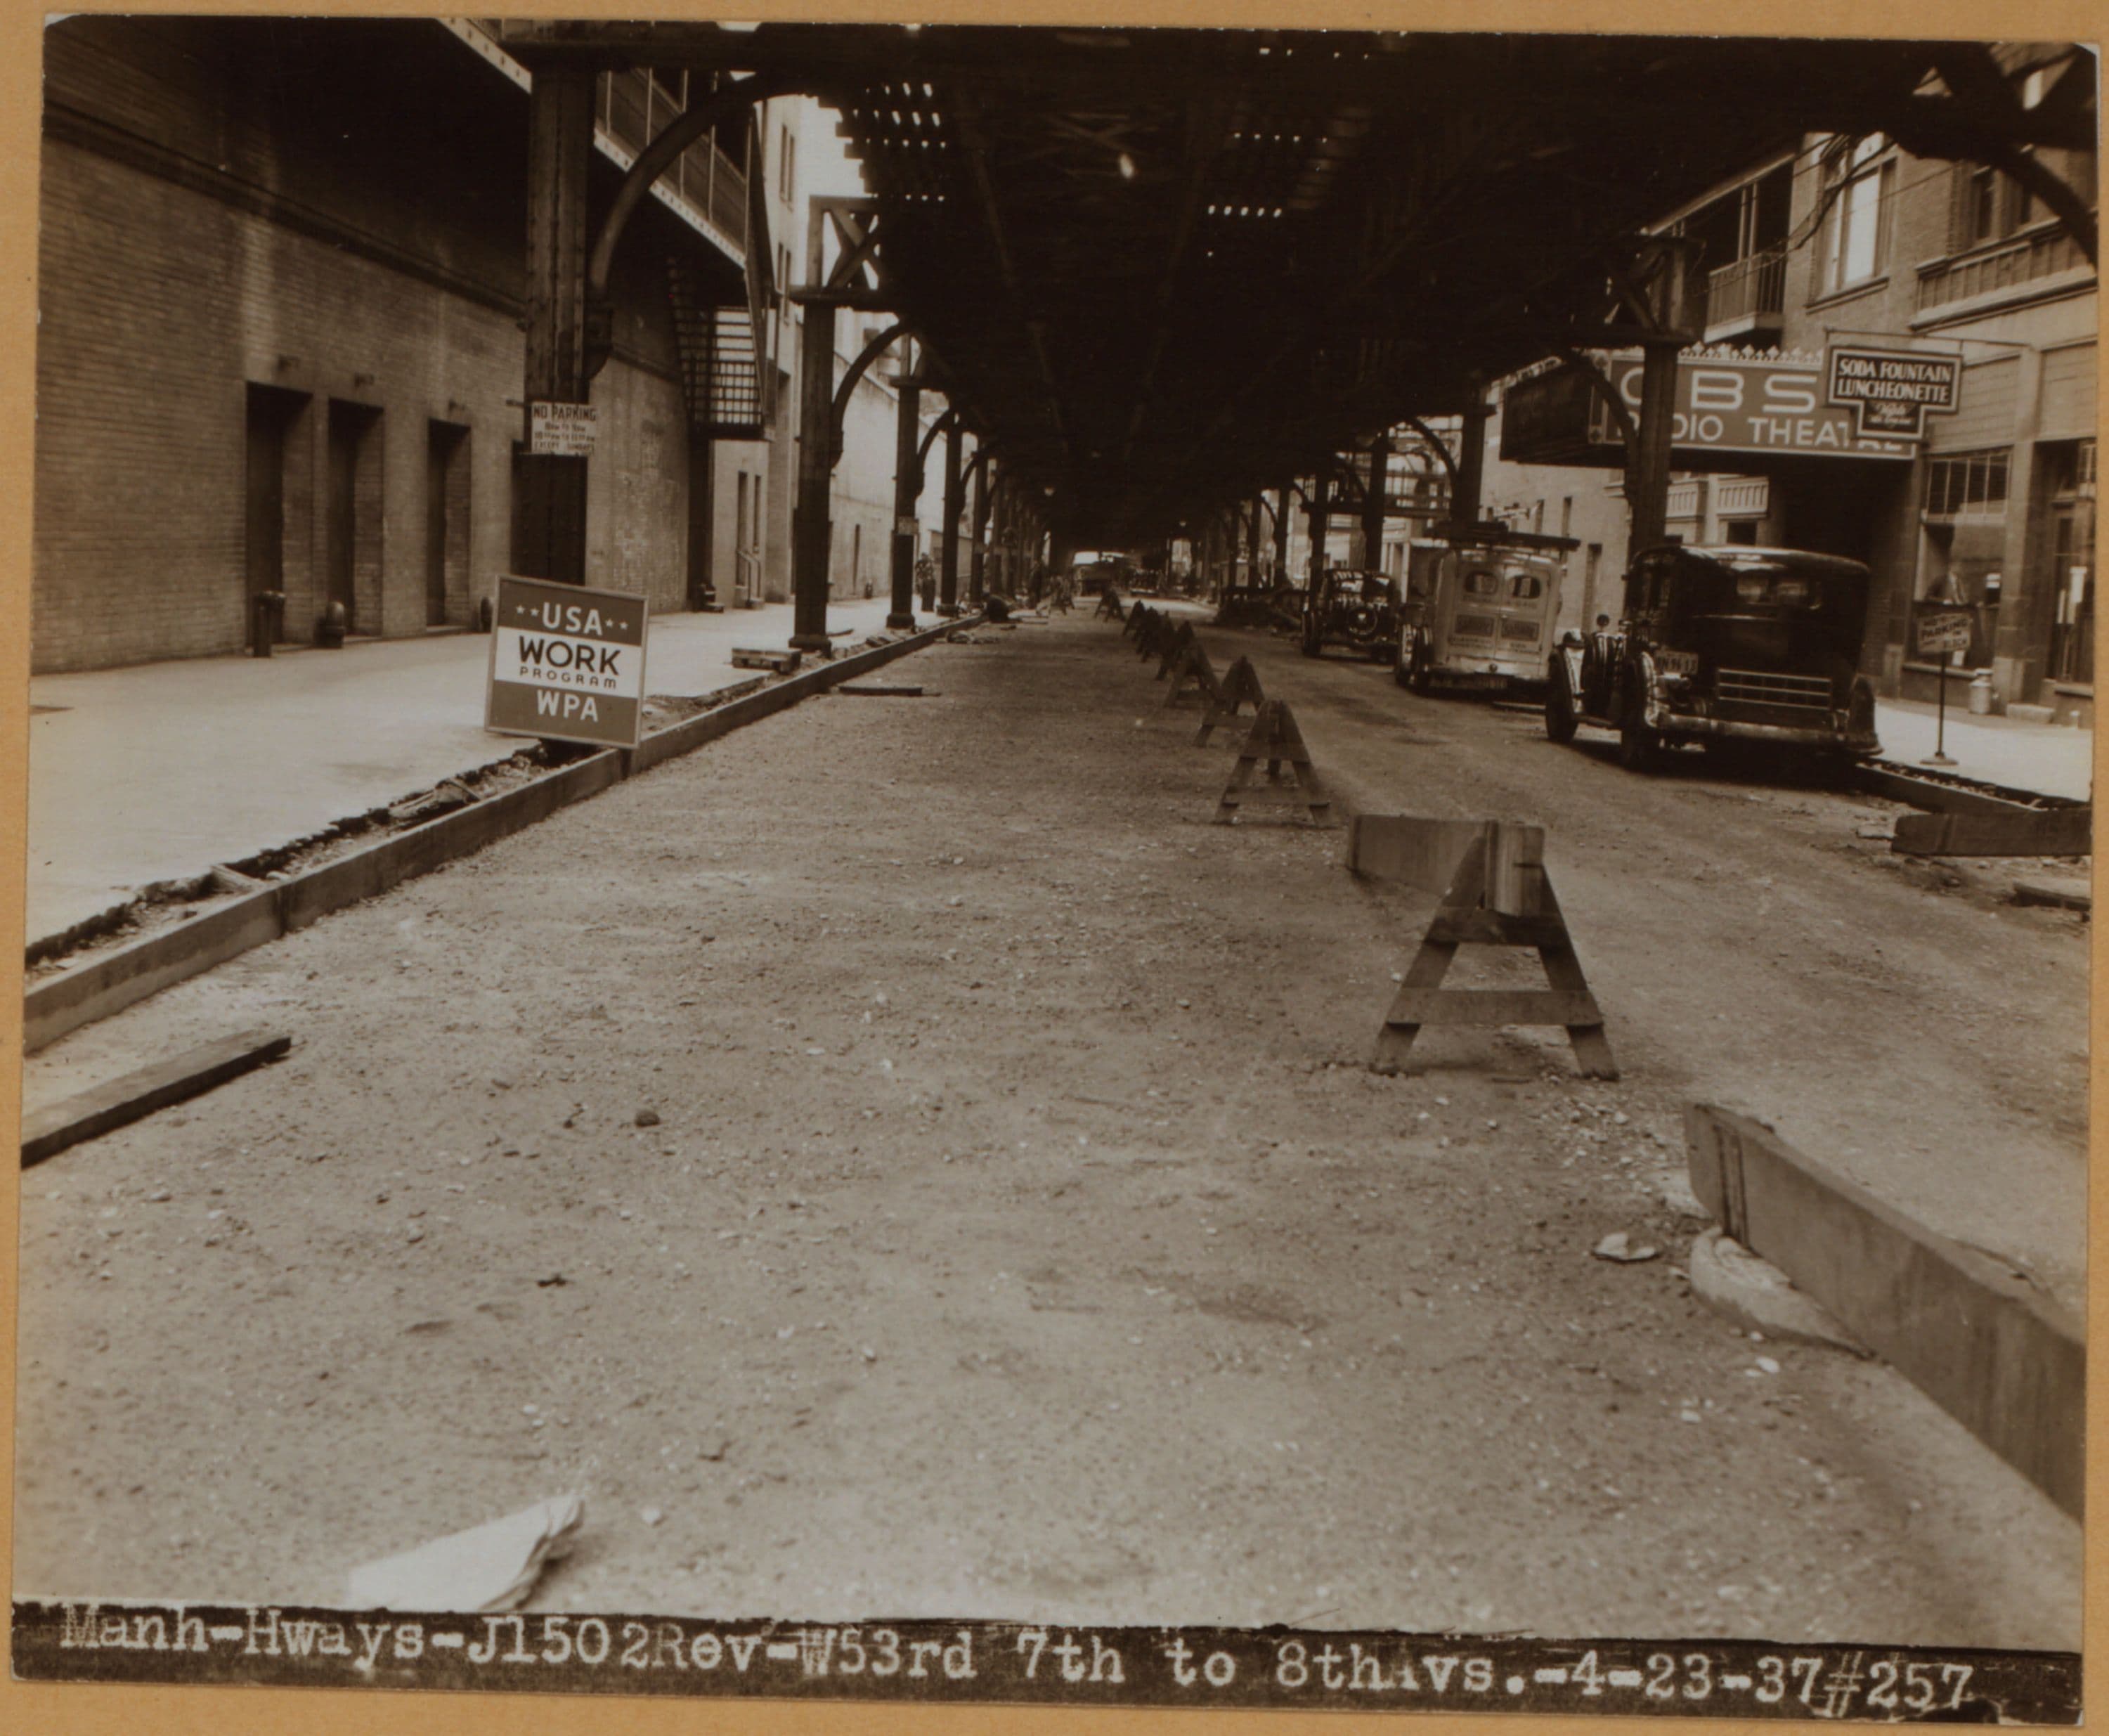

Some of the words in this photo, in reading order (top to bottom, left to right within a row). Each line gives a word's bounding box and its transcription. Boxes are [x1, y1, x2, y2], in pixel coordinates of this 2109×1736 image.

[1838, 358, 1876, 377] SODA
[1879, 361, 1952, 382] FOUNTAIN
[1621, 366, 1818, 413] CBS
[1836, 378, 1949, 403] LUNCHEONETTE
[533, 405, 547, 419] NO
[551, 404, 597, 422] PARKING
[1748, 416, 1903, 451] THEAT
[542, 602, 603, 636] USA
[519, 635, 622, 676] WORK
[519, 666, 617, 689] PROGRAM
[536, 689, 598, 723] WPA
